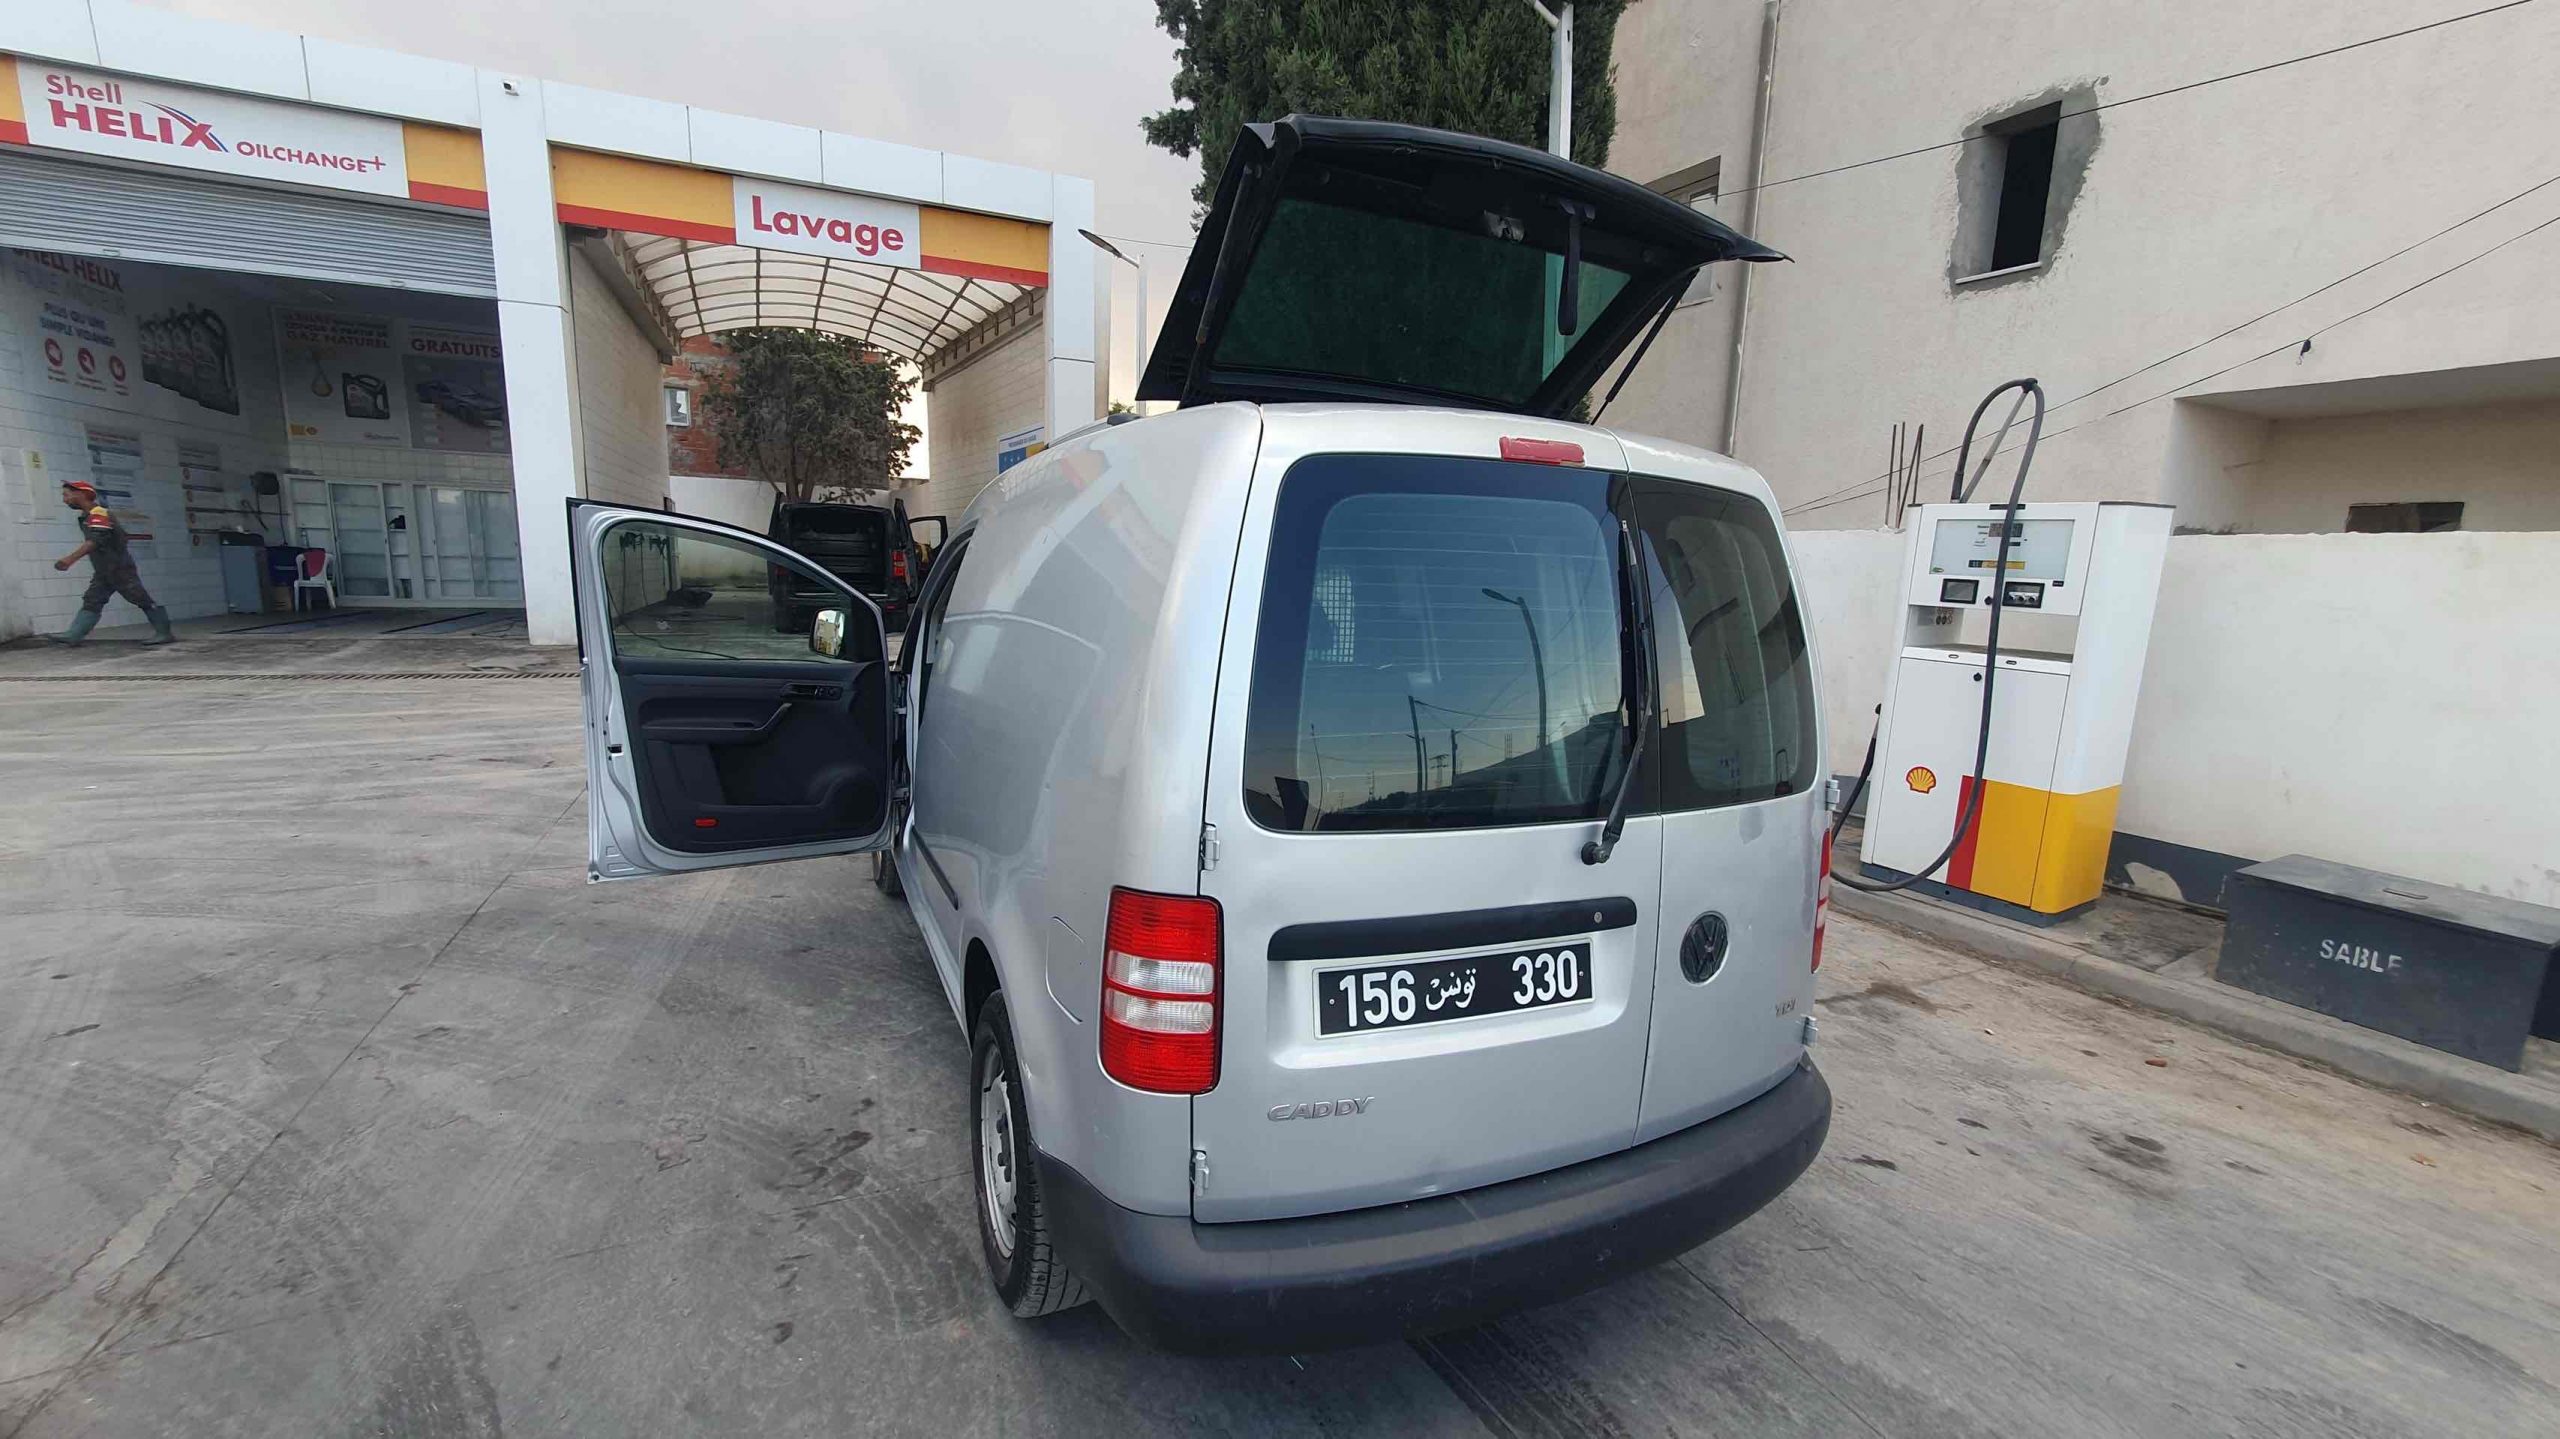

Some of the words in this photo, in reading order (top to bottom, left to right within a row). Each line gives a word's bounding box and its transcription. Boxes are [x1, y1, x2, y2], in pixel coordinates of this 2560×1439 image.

[45, 73, 123, 105] Shell
[48, 98, 229, 153] HELIX
[751, 194, 905, 257] Lavage
[73, 256, 123, 293] HELIX
[411, 337, 502, 359] GRATUITS
[2318, 938, 2403, 977] SABLE
[1338, 969, 1417, 1028] 156
[1425, 967, 1478, 1011] تونس
[1510, 949, 1580, 1007] 330
[1266, 1096, 1376, 1123] CADDY
